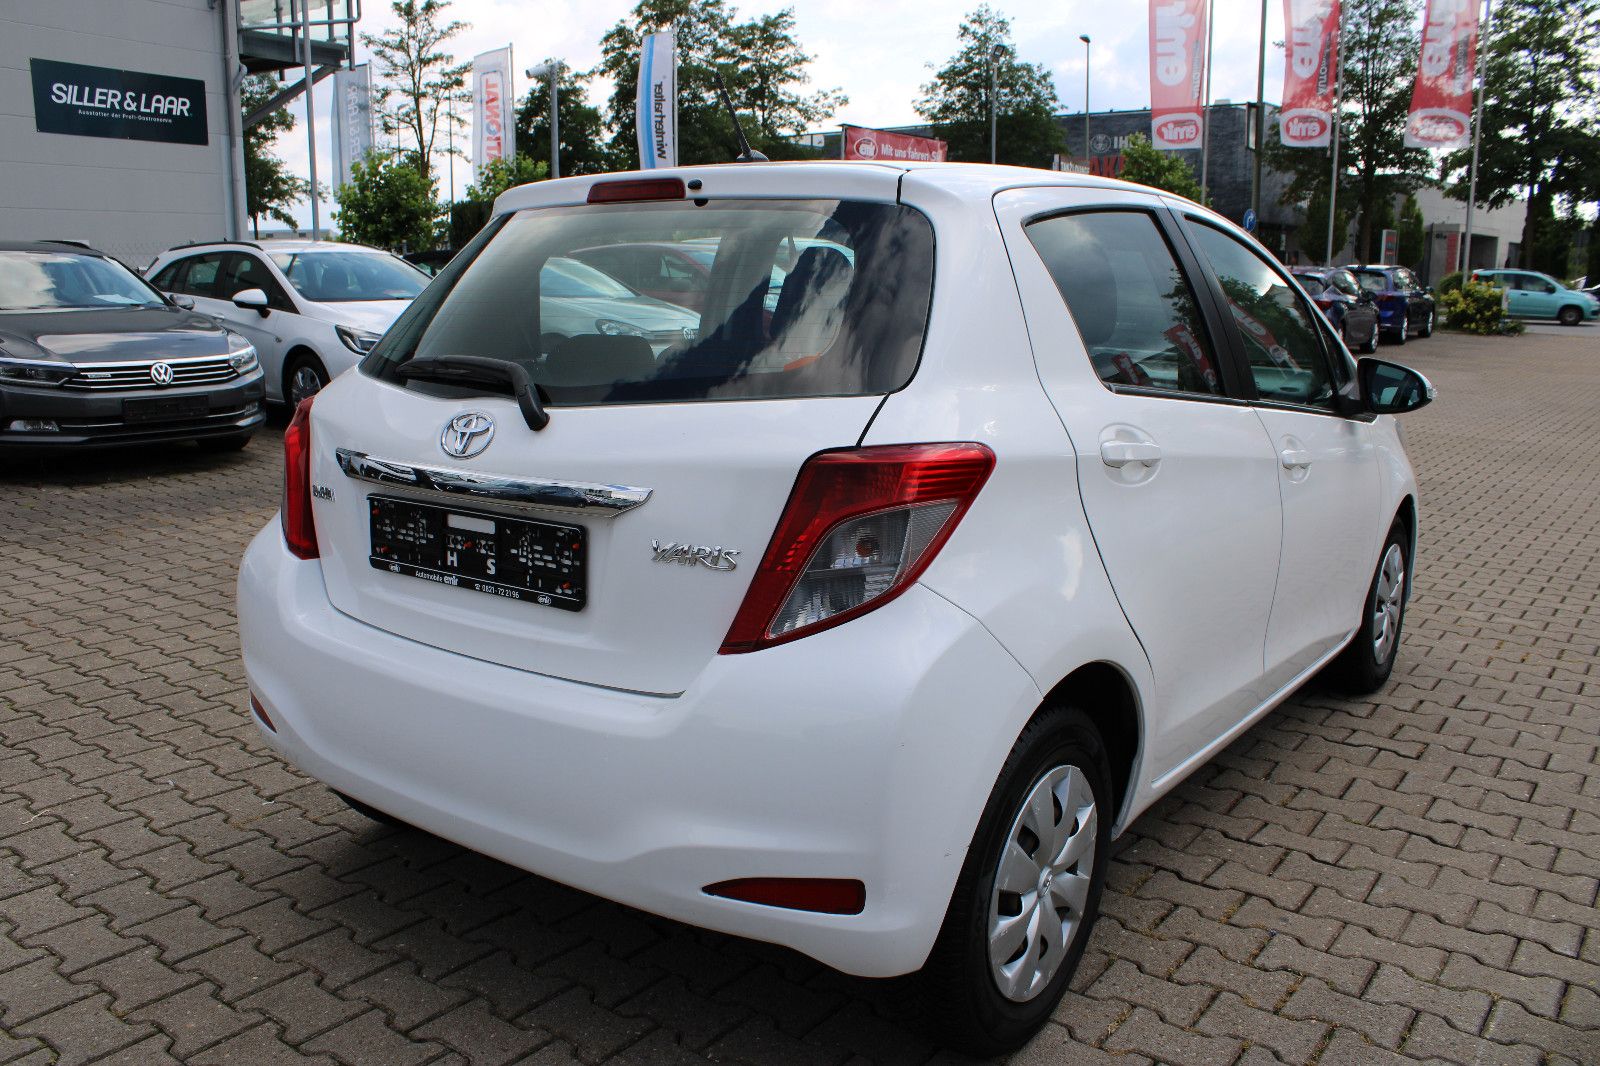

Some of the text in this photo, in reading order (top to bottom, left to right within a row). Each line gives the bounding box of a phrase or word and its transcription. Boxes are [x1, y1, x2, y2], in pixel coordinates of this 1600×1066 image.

[51, 82, 191, 117] SILLER & LAAR
[415, 570, 459, 587] Automobile emir
